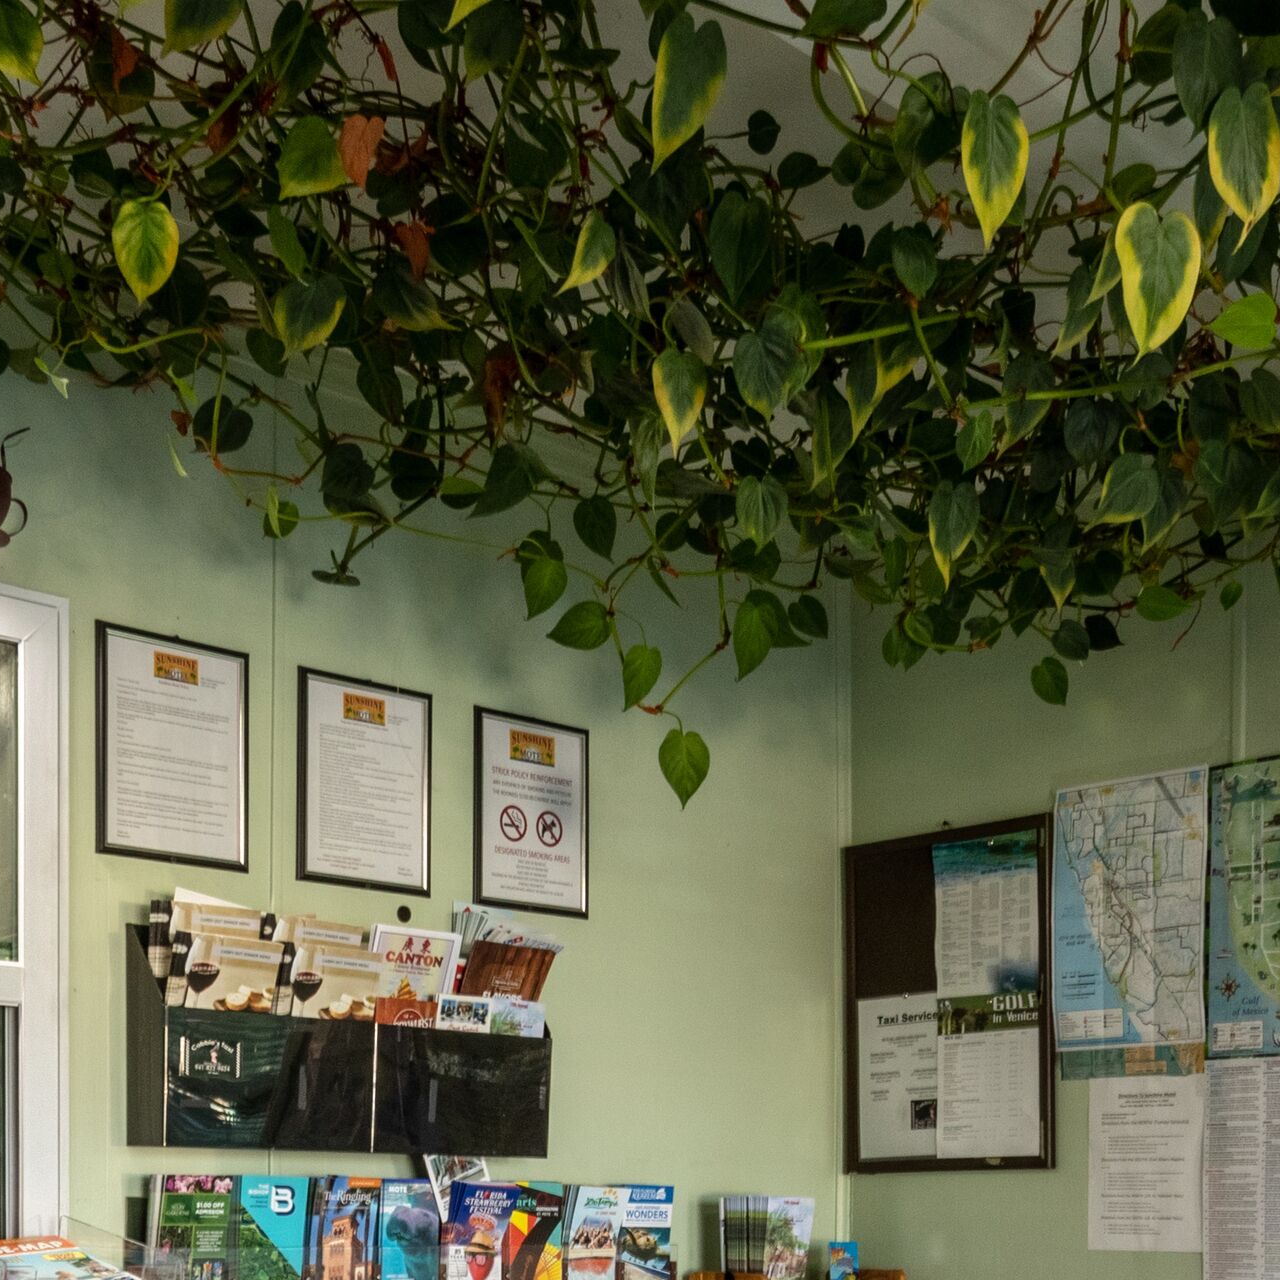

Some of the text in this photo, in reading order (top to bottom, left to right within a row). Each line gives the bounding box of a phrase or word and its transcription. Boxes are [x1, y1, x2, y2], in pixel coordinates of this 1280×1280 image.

[155, 651, 198, 671] SUNSHINE
[344, 693, 385, 711] SUNSHINE
[511, 730, 554, 750] SUNSHINE
[385, 951, 444, 968] CANTON
[992, 992, 1037, 1012] GOLF
[1241, 996, 1260, 1006] Gulf
[877, 1011, 937, 1026] Taxi Service
[1007, 1010, 1038, 1022] Venice
[1232, 1005, 1269, 1017] of Mexico
[324, 1189, 372, 1205] The Ringling
[516, 1198, 537, 1210] arts
[470, 1206, 503, 1215] FESTIVAL
[625, 1209, 669, 1219] WONDERS
